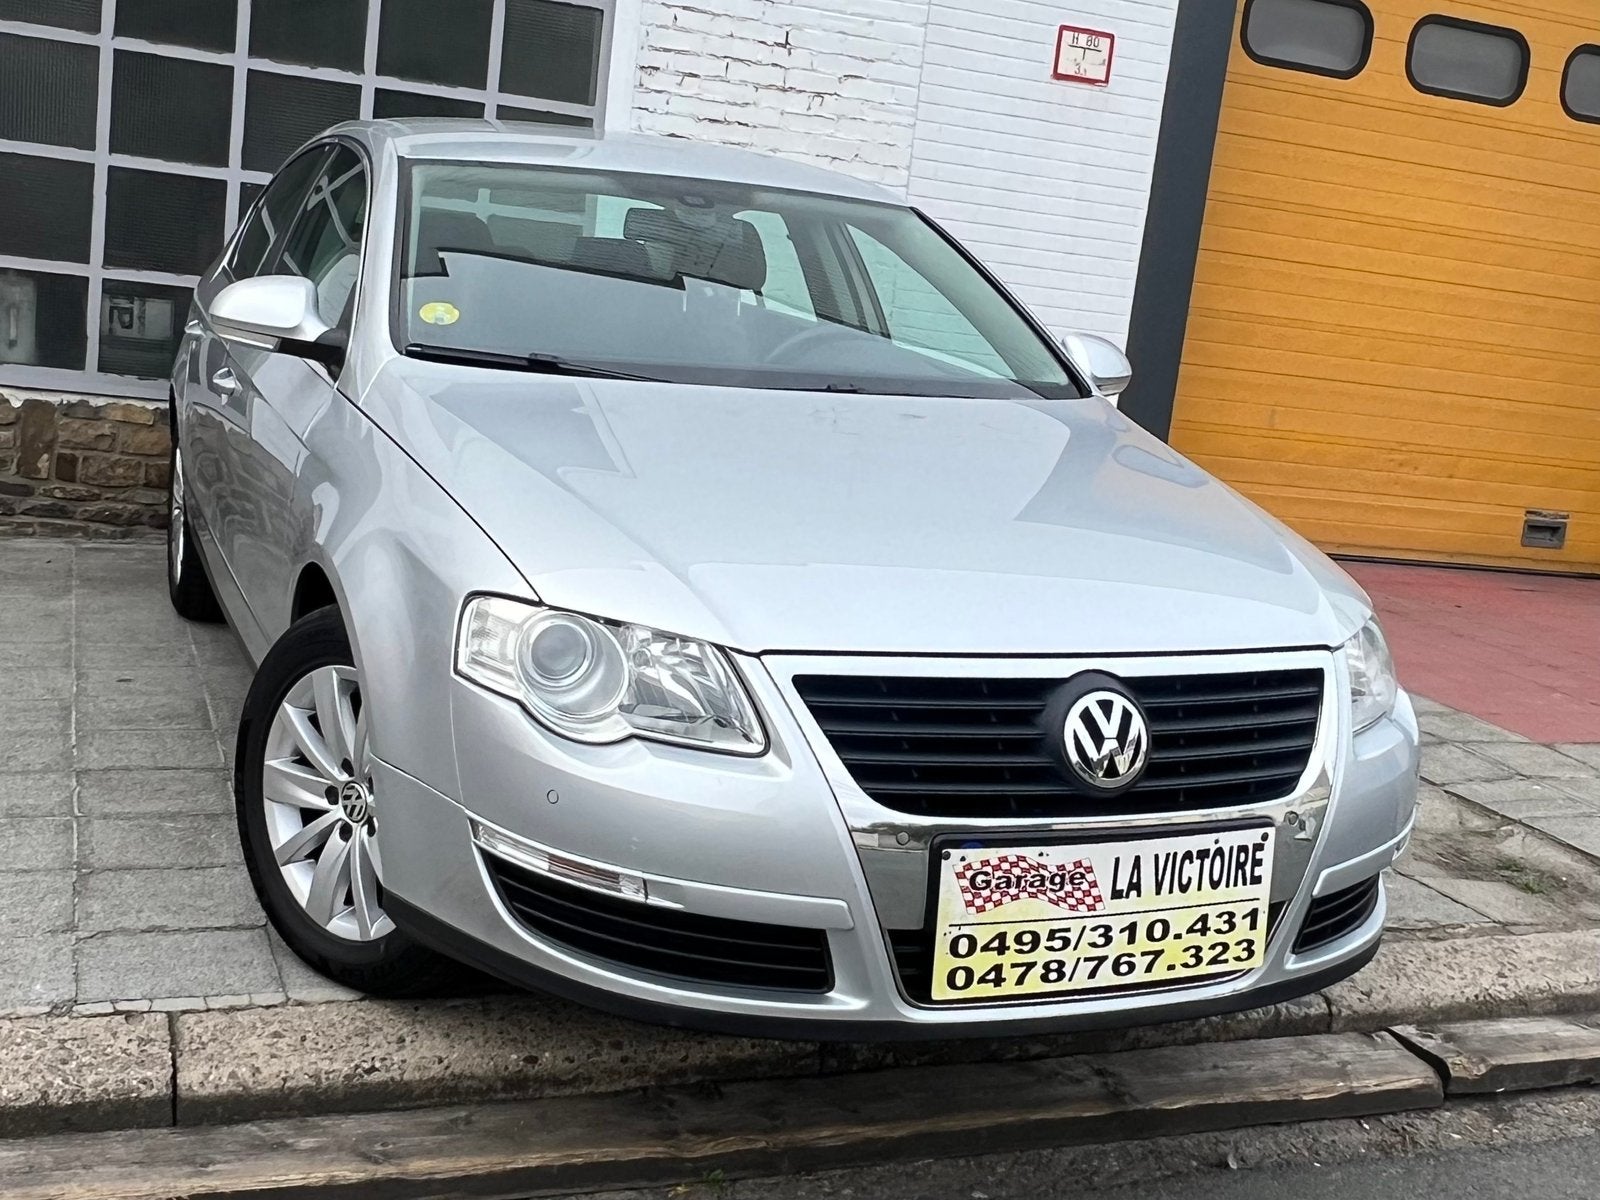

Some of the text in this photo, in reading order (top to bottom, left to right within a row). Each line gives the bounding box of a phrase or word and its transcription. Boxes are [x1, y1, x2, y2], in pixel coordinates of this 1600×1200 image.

[969, 843, 1265, 900] Garage LA VICTOIRE
[949, 908, 1260, 959] 0495/310.431
[946, 939, 1256, 991] 0478/767.323
